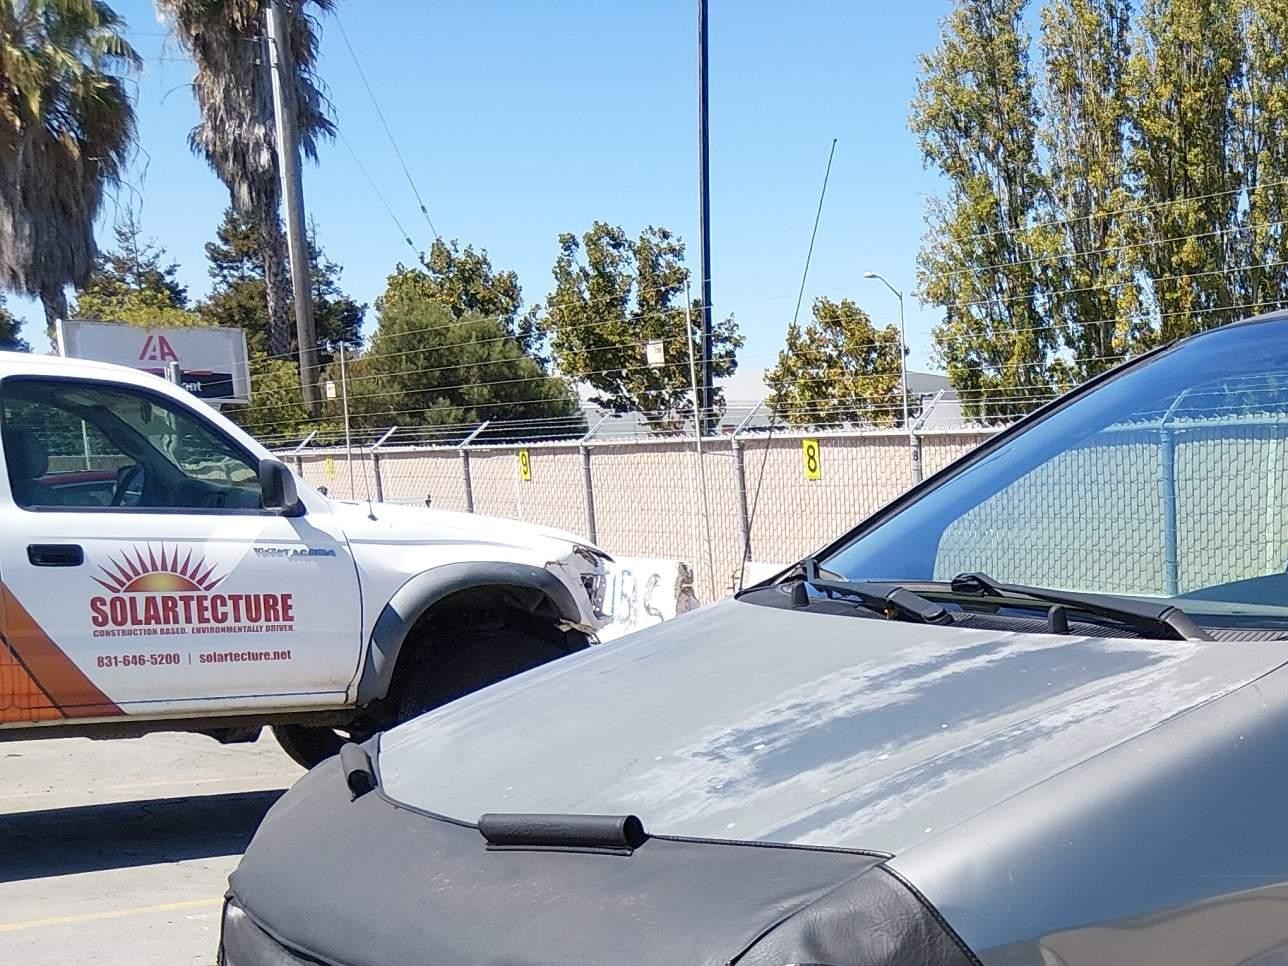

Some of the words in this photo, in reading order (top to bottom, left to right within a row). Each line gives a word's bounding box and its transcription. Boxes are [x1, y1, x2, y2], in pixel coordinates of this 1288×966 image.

[521, 453, 528, 475] 9
[807, 444, 817, 473] 8
[90, 593, 295, 627] SOLARTECTURE
[93, 627, 158, 637] CONSTRUCTION
[160, 626, 189, 636] BASED.
[191, 624, 263, 635] ENVIRONMENTALLY
[265, 624, 296, 633] DRIVEN.
[97, 653, 181, 668] 831-646-5200
[199, 650, 292, 664] solartecture.net
